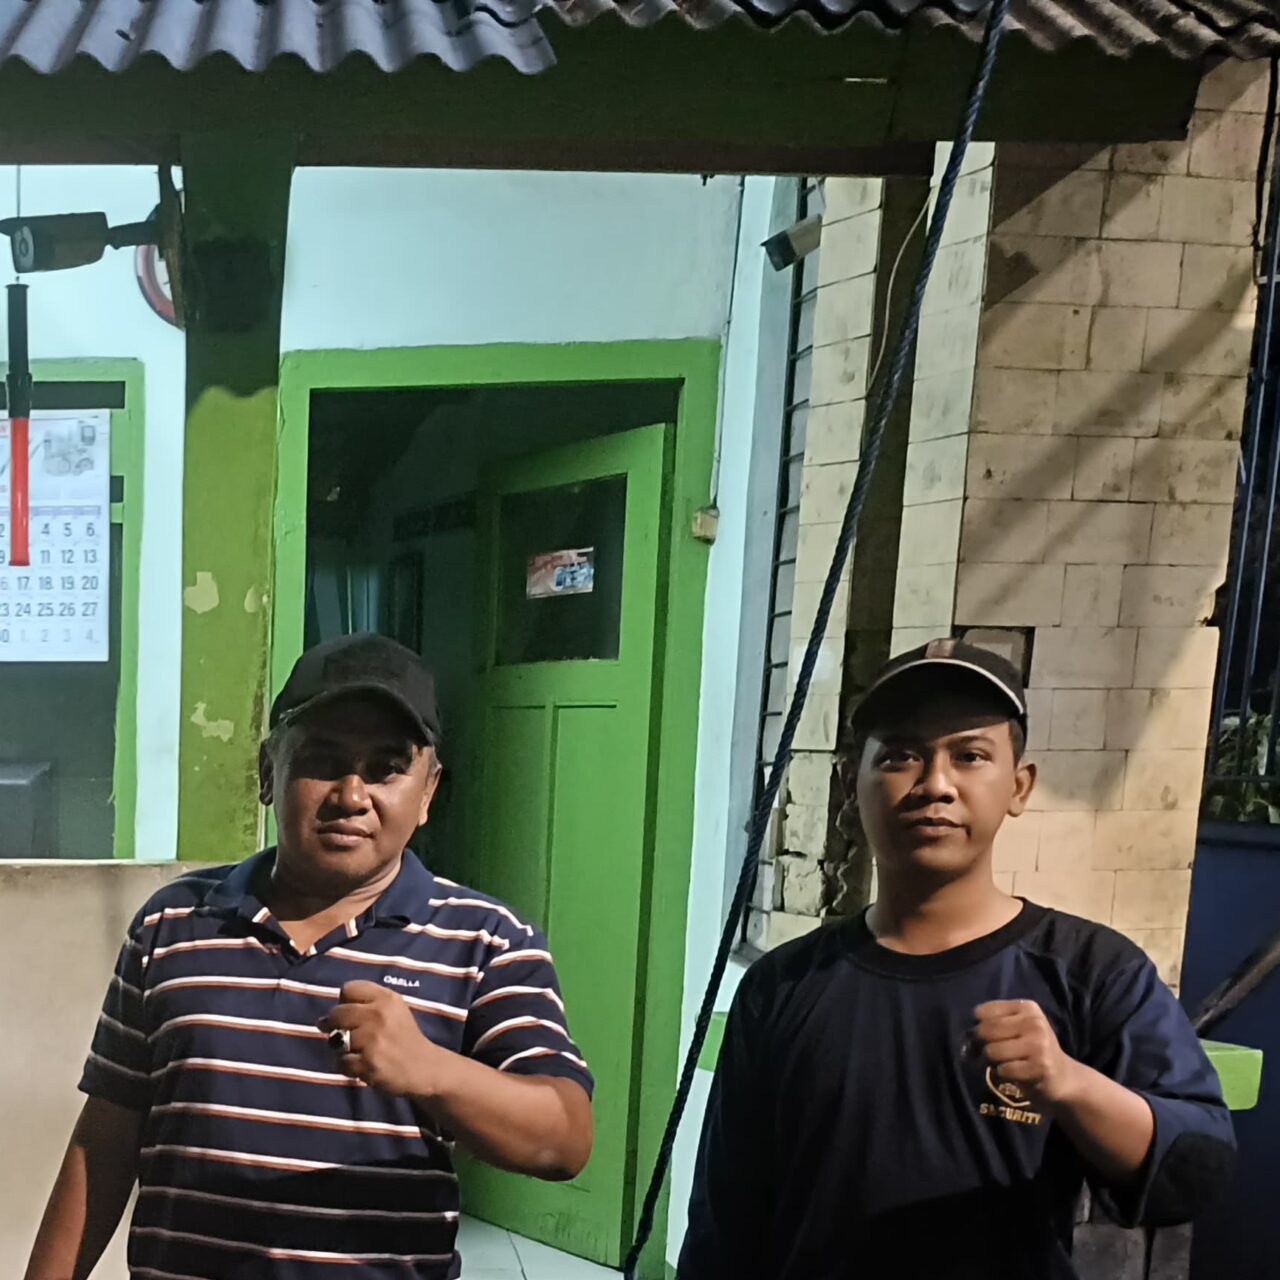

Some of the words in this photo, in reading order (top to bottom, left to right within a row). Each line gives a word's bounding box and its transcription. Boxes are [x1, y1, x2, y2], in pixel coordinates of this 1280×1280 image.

[41, 523, 50, 537] 4
[63, 523, 72, 537] 5
[86, 523, 95, 537] 6
[40, 549, 51, 564] 11
[61, 549, 74, 564] 12
[84, 549, 98, 564] 13
[17, 576, 30, 591] 17
[38, 576, 53, 591] 18
[61, 576, 75, 591] 19
[81, 576, 99, 591] 20
[15, 602, 31, 617] 24
[37, 602, 54, 617] 25
[59, 602, 76, 617] 26
[81, 602, 98, 617] 27
[41, 628, 49, 643] 2
[85, 628, 94, 643] 4
